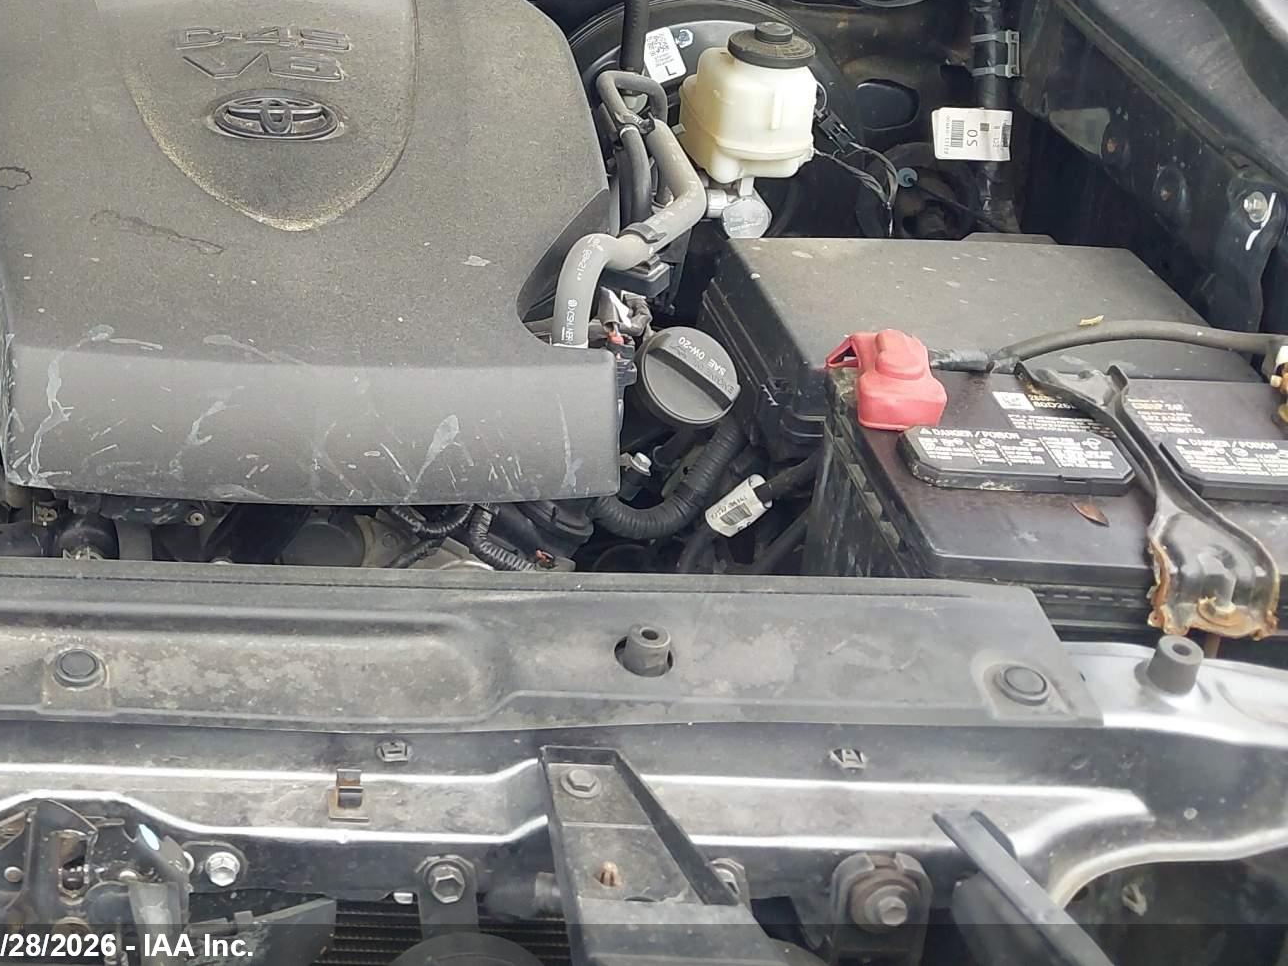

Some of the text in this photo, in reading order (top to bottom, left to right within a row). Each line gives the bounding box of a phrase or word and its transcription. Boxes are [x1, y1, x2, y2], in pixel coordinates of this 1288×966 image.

[182, 51, 345, 83] V6
[664, 65, 678, 76] L
[677, 336, 706, 360] 0W-20
[707, 359, 727, 376] SAE
